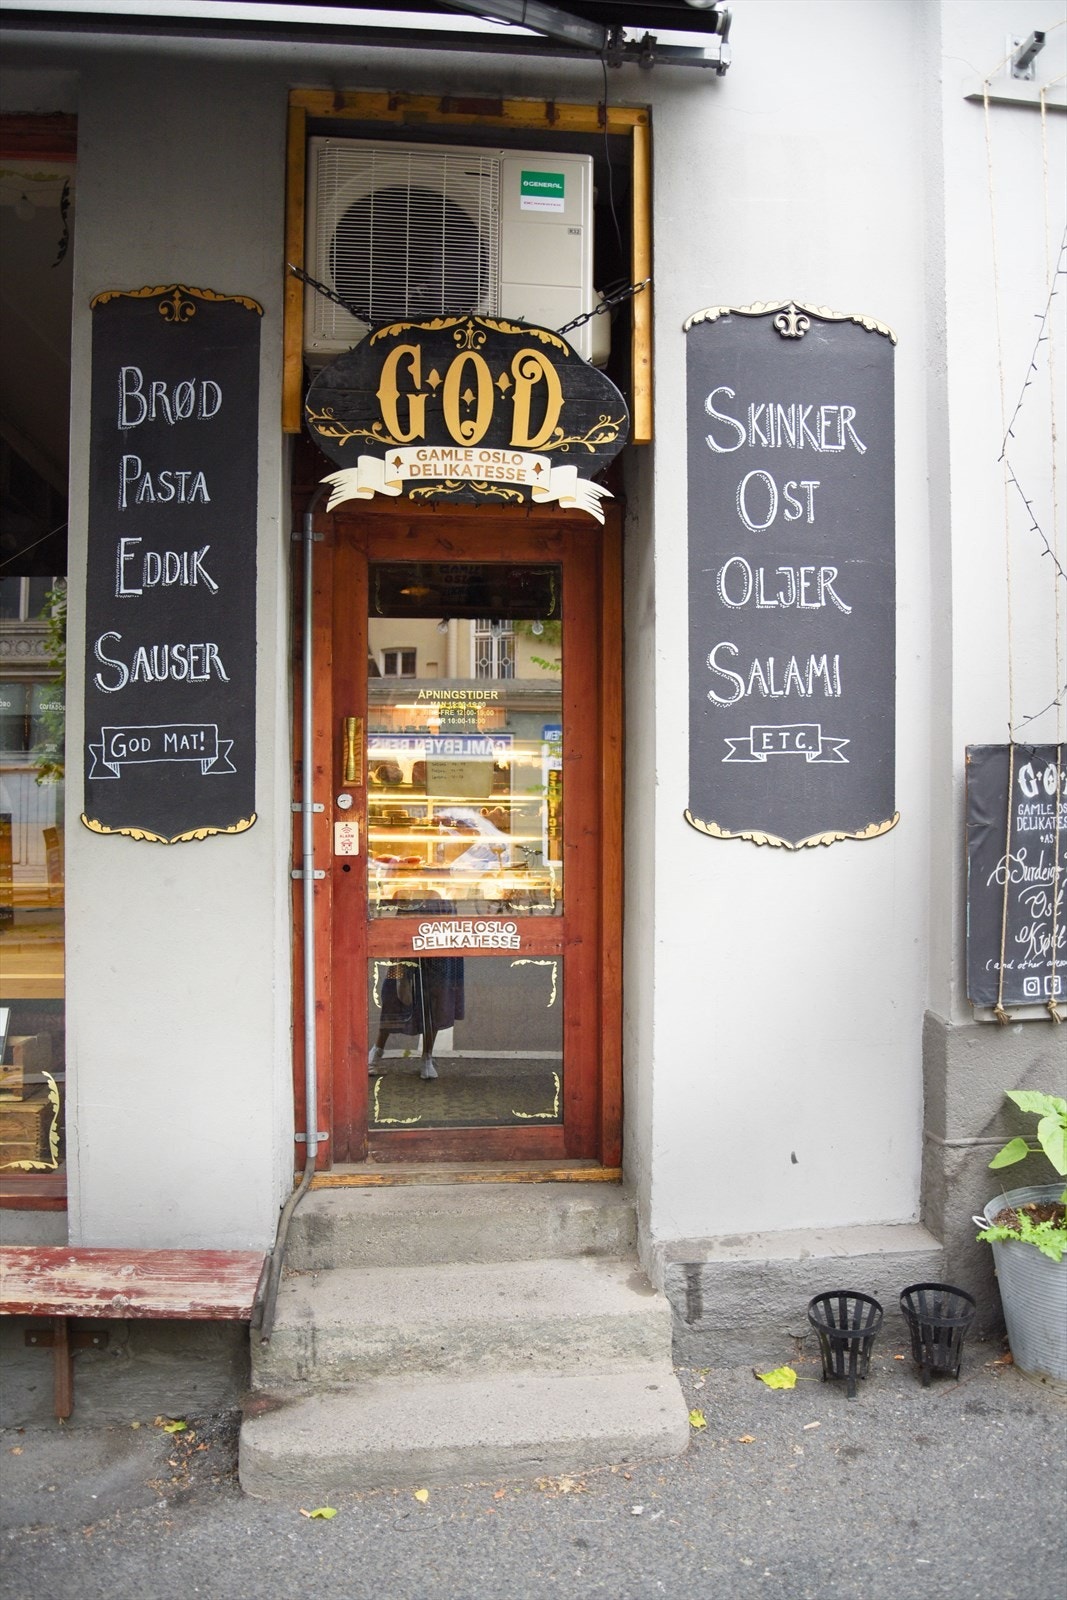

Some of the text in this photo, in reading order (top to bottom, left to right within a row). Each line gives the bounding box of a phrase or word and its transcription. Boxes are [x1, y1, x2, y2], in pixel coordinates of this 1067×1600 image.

[118, 366, 223, 430] BRØD
[704, 386, 867, 454] SKINKER
[409, 464, 526, 482] DELIKATESSE
[417, 450, 523, 466] GAMLE OSLO
[118, 454, 210, 510] PASTA
[736, 470, 820, 532] OST
[115, 537, 219, 598] EDDIK
[717, 556, 852, 614] OLJER
[94, 632, 230, 693] SAUSER
[707, 642, 841, 708] SALAMI
[111, 731, 205, 757] GOD MAT!
[762, 732, 813, 750] ETC.
[1018, 804, 1054, 815] GAMLE
[1045, 833, 1054, 843] AS
[414, 935, 519, 948] DELIKATESSE
[420, 922, 516, 934] GAMLE OSLO
